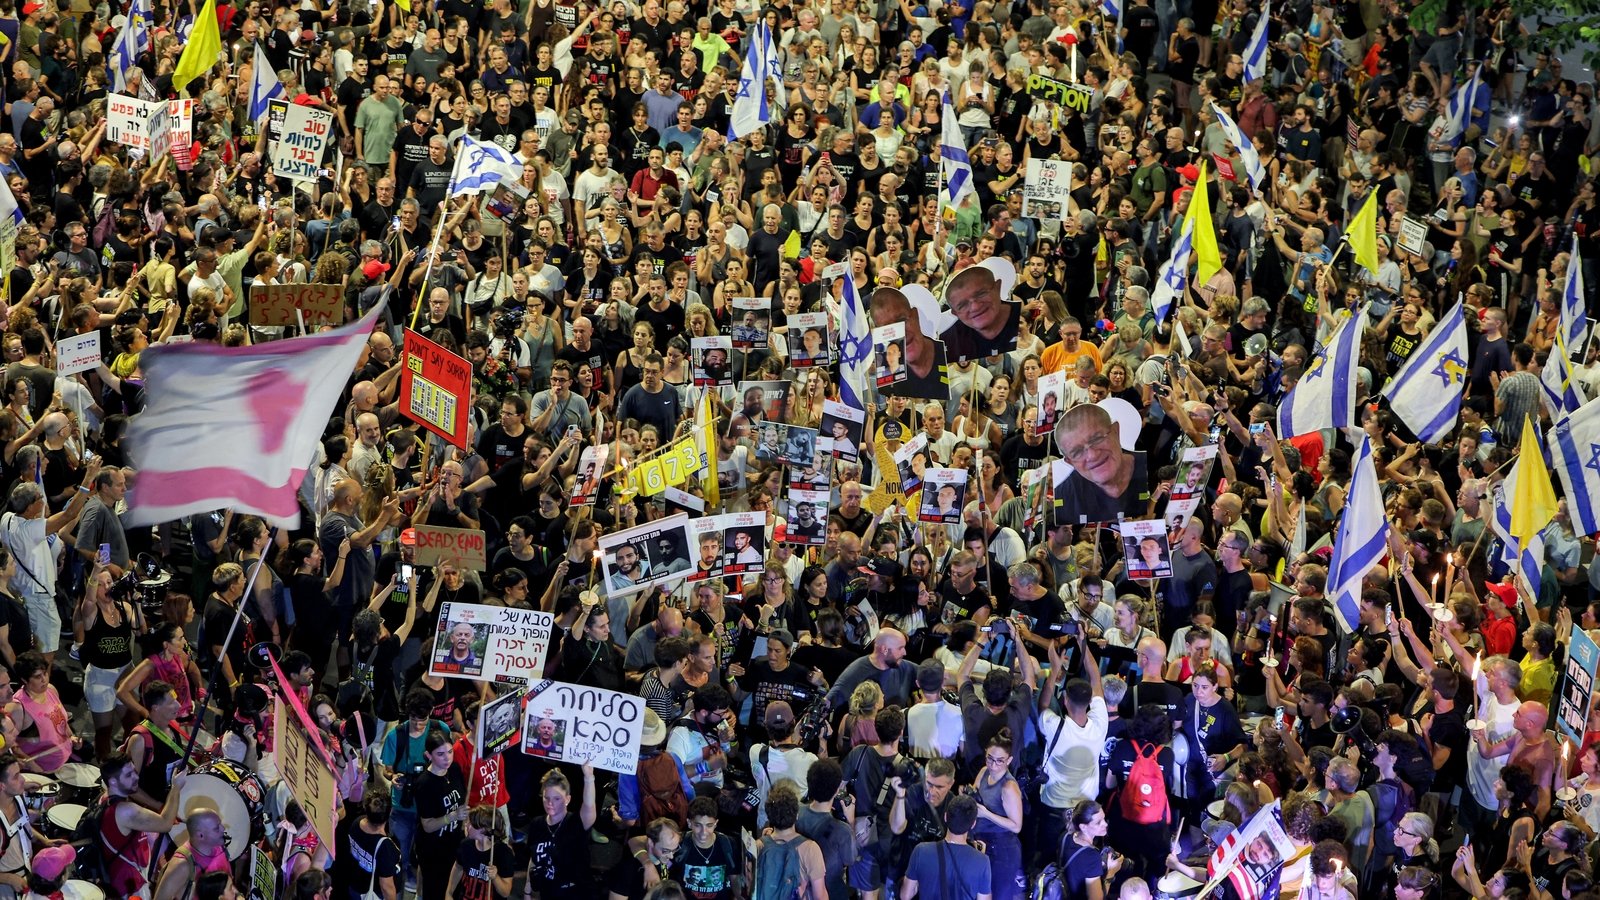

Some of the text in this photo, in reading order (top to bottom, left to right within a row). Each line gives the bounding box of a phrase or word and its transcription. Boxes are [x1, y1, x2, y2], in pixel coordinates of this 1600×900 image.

[135, 103, 148, 118] לא
[128, 120, 140, 132] זה
[291, 147, 315, 163] בעד
[280, 159, 317, 177] ארצנו
[77, 339, 96, 350] סדום
[72, 354, 101, 367] ממשלה
[408, 355, 422, 372] GET
[431, 351, 444, 376] SAY
[446, 360, 469, 391] SORRY
[416, 530, 484, 553] DEAD END
[499, 608, 551, 627] סבא שלי
[520, 627, 549, 640] הופקר
[497, 638, 525, 651] זכרו
[495, 652, 537, 672] עסקה
[556, 686, 638, 723] סליחה
[572, 716, 630, 748] סבא
[610, 747, 632, 759] הופקר
[443, 789, 460, 808] חיים
